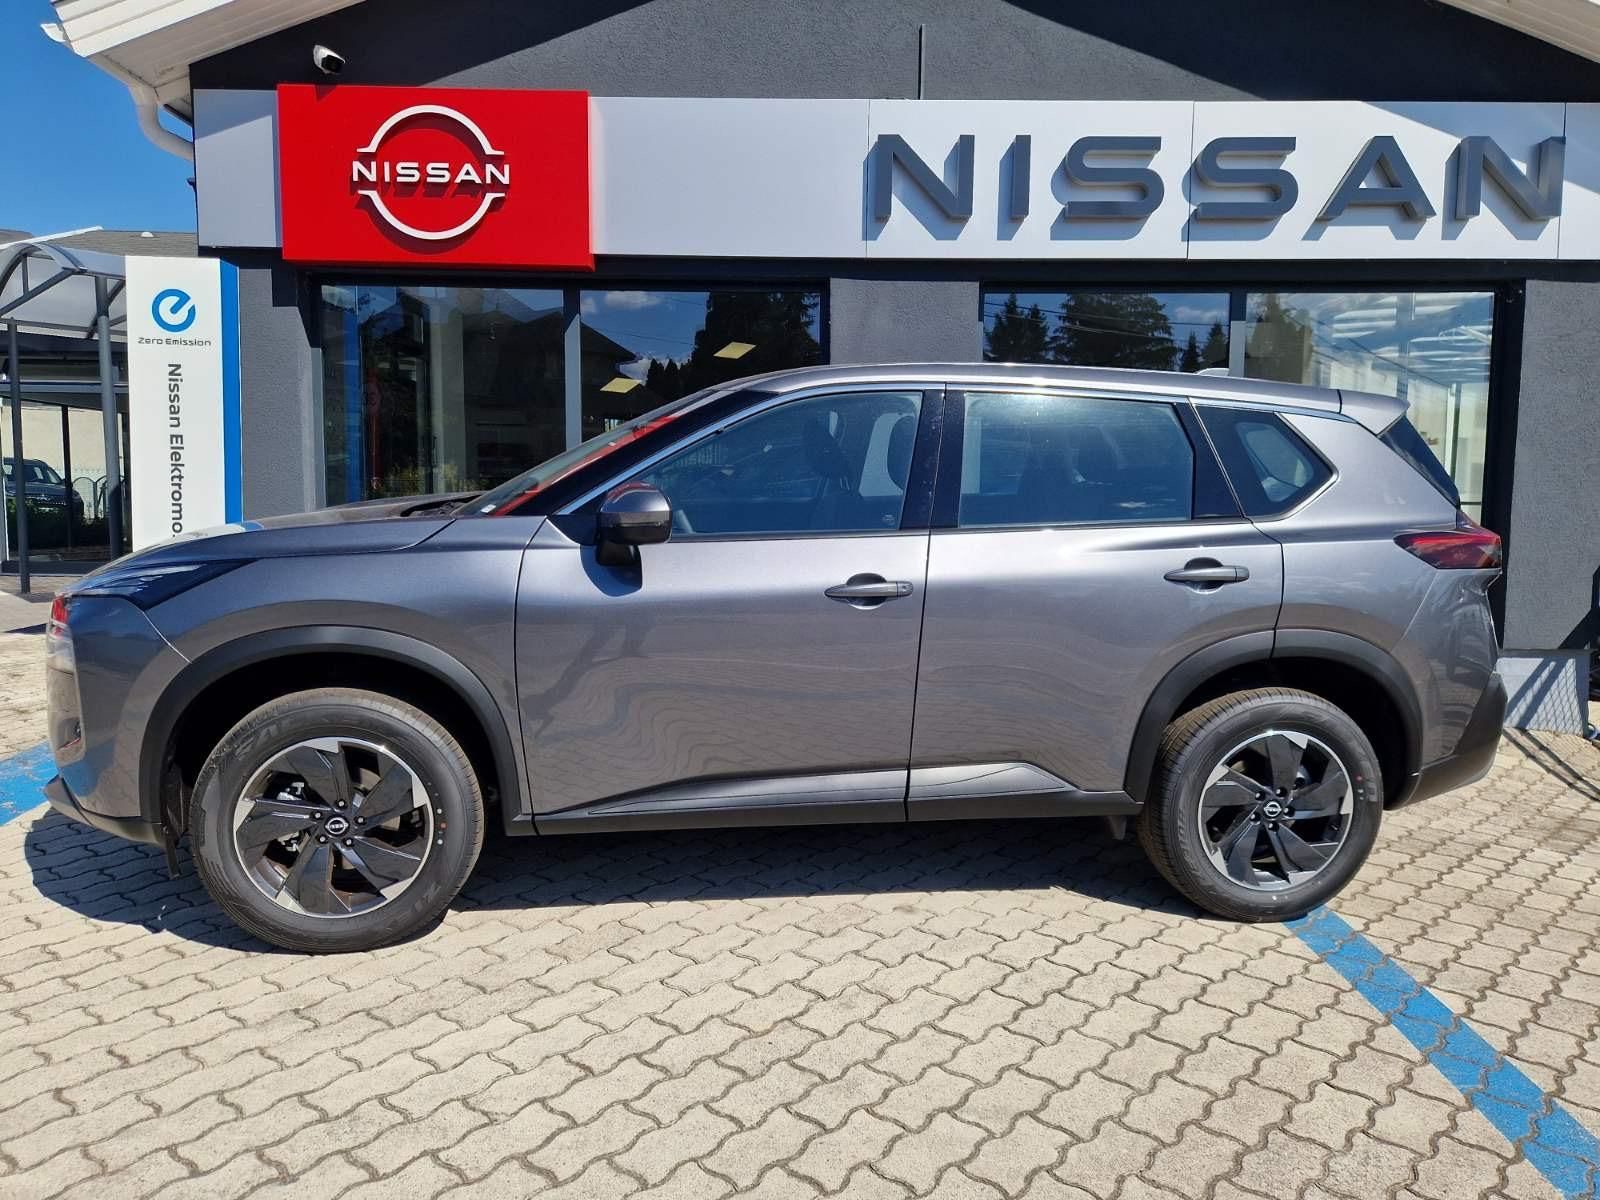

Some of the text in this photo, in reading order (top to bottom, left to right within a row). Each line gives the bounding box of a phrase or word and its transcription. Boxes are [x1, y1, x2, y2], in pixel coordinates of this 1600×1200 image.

[352, 160, 510, 185] NISSAN
[874, 134, 1566, 222] NISSAN
[138, 337, 211, 346] Zero Emission
[167, 363, 185, 538] Nissan Elektromo
